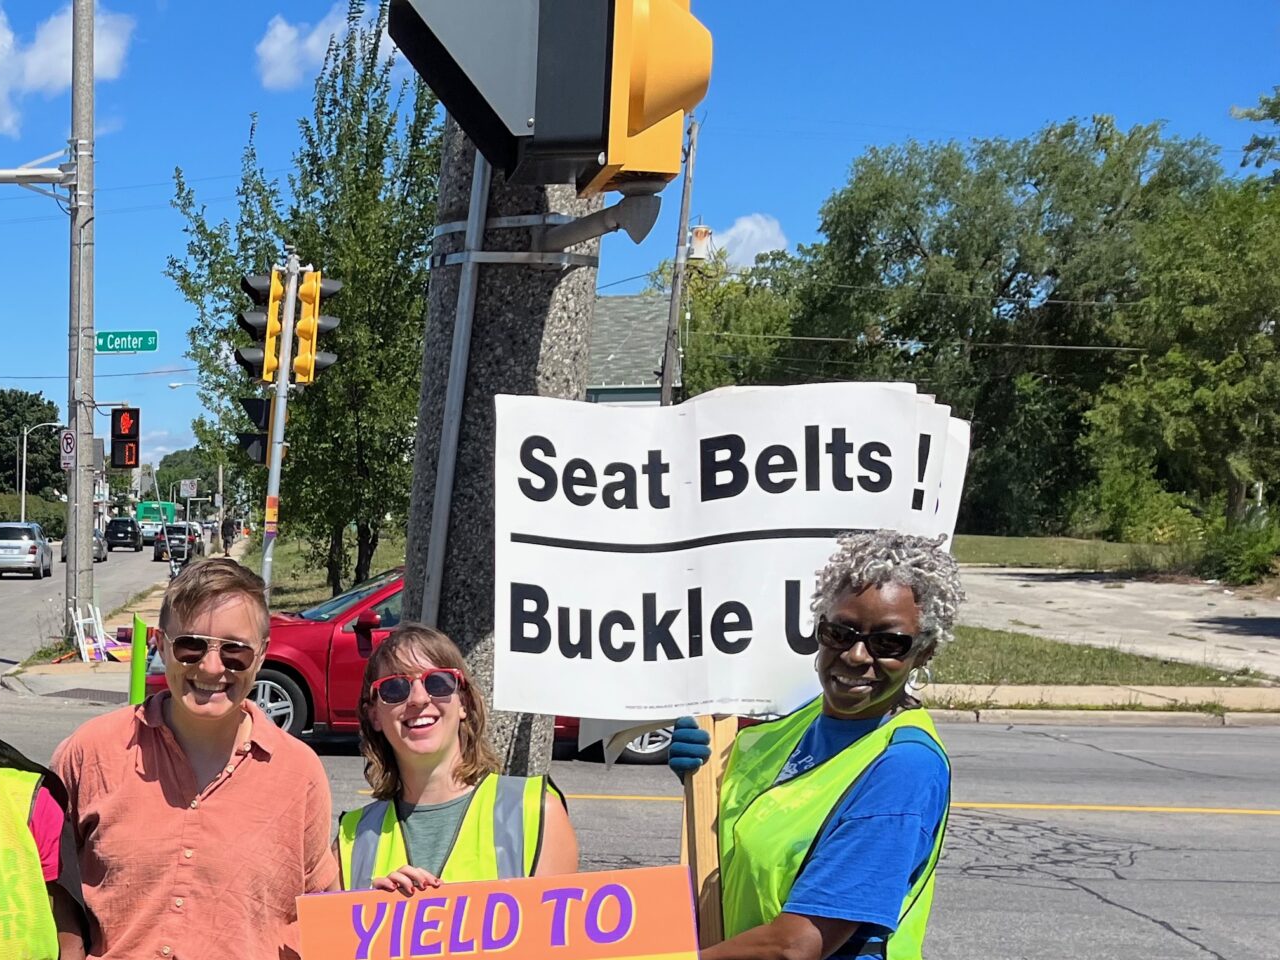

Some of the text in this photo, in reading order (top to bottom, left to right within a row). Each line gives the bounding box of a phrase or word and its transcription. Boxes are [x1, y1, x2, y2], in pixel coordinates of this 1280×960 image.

[107, 334, 144, 349] Center
[147, 336, 156, 345] ST
[517, 435, 670, 510] Seat
[699, 425, 893, 503] Belts
[510, 580, 820, 662] Buckle U
[541, 883, 637, 948] TO
